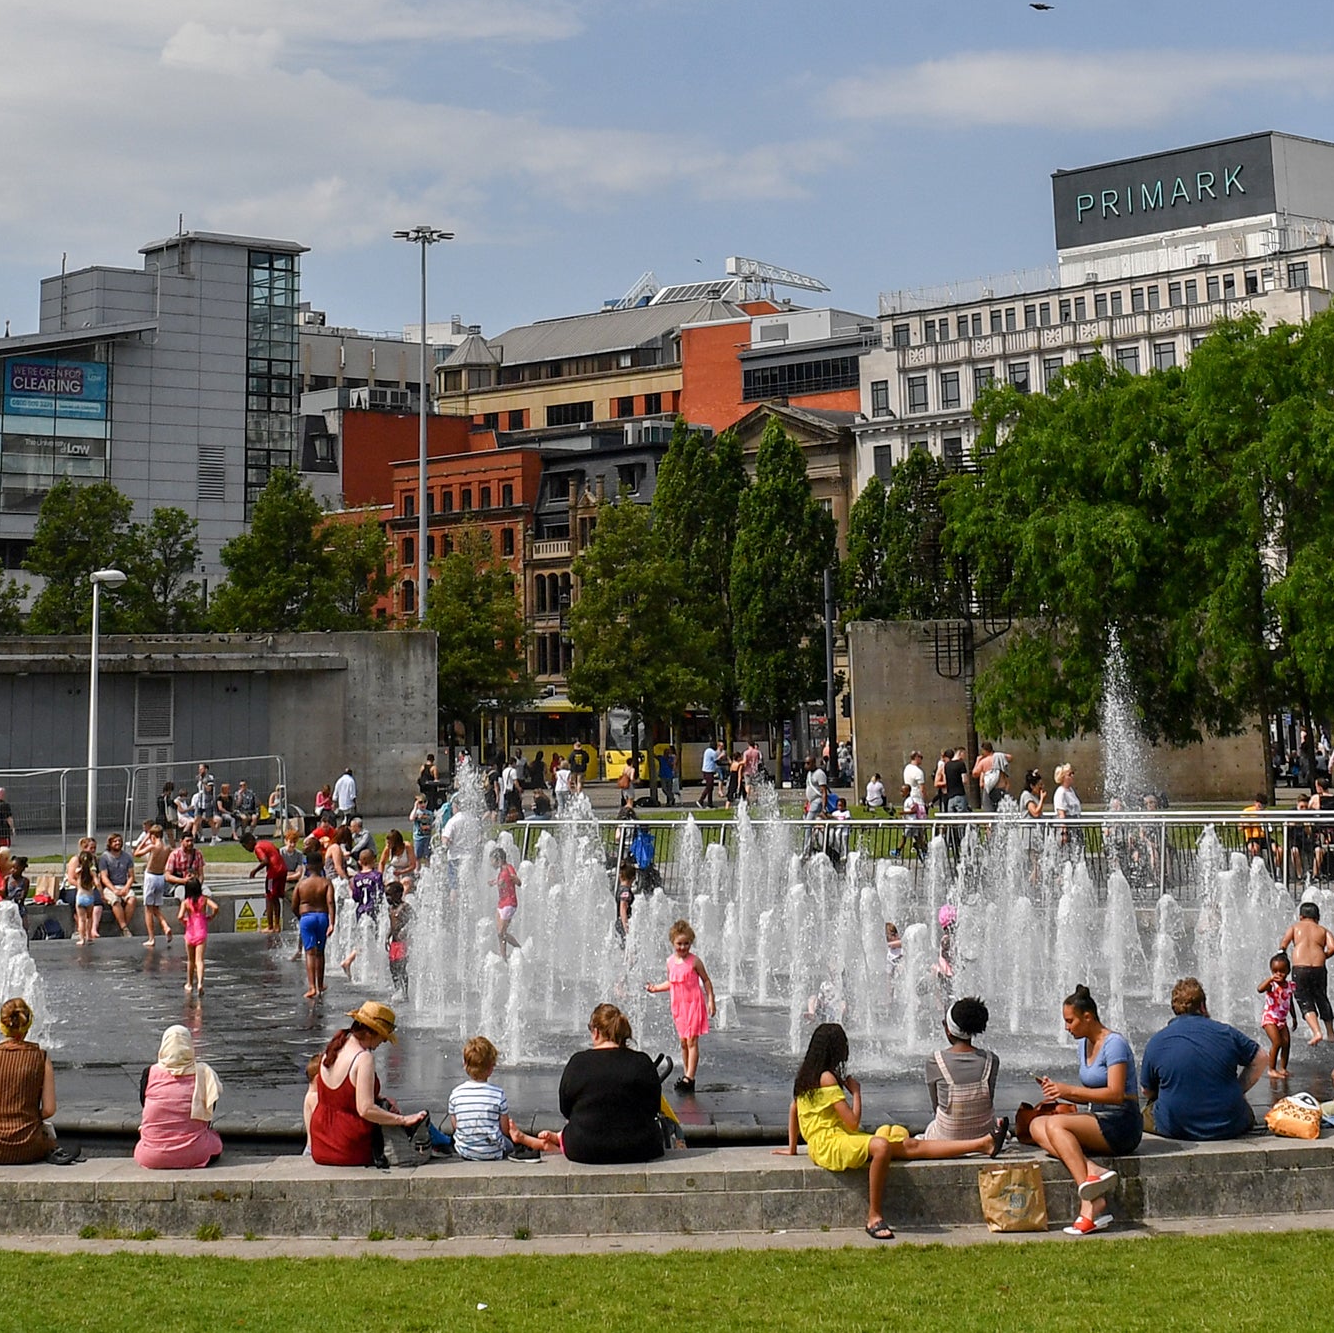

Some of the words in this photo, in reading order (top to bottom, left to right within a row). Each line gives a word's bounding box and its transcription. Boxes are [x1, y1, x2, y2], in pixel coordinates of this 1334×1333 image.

[1076, 165, 1246, 223] PRIMARK
[38, 368, 63, 378] OPEN
[64, 370, 81, 379] FOR
[13, 377, 81, 393] CLEARING
[67, 442, 90, 455] Law
